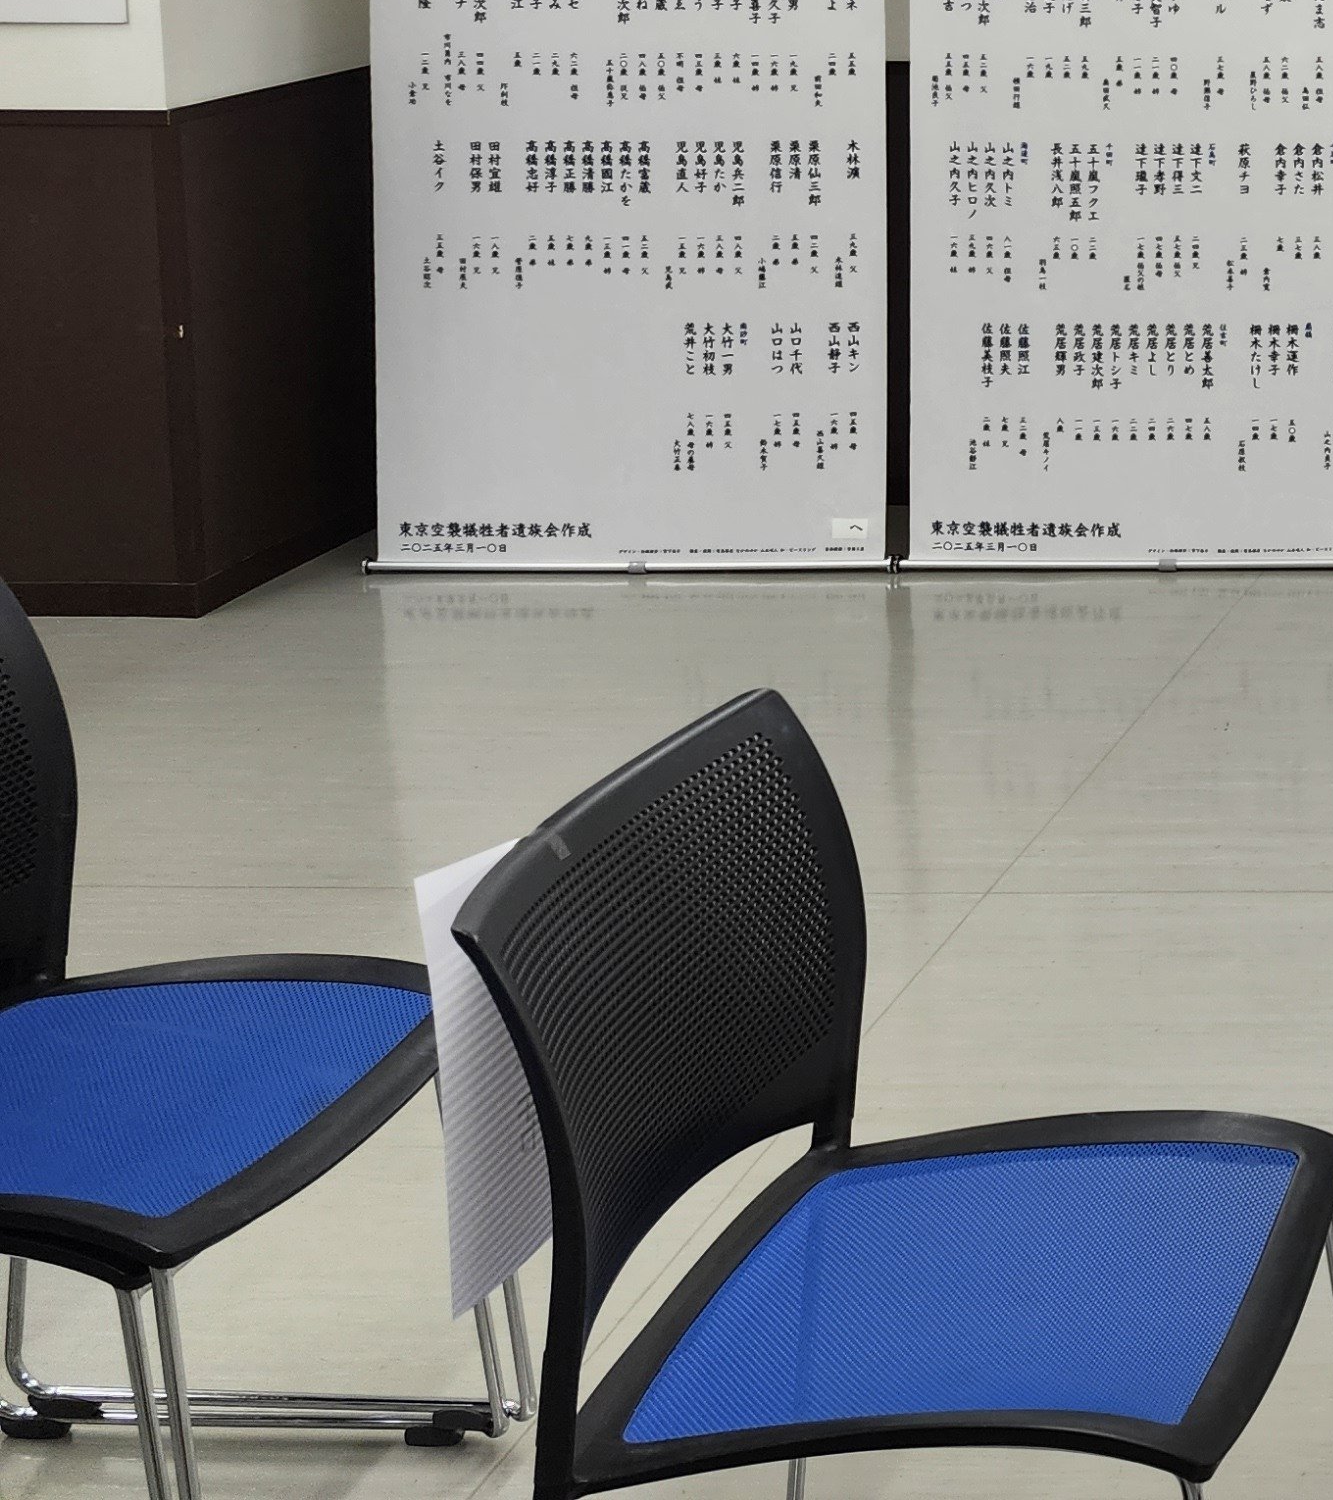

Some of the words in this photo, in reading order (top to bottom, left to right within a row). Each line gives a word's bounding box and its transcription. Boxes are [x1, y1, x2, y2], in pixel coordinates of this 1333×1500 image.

[432, 139, 448, 193] 土谷イク
[983, 141, 998, 208] 山之内久次
[1292, 142, 1307, 195] 倉内さた
[720, 321, 735, 377] 大竹一男
[788, 322, 803, 375] 山口千代
[846, 321, 861, 373] 西山キン
[1072, 322, 1087, 377] 荒居政子
[1145, 322, 1160, 377] 荒居よし
[398, 521, 592, 539] 東京空襲犠牲者遺族会作成
[930, 519, 1122, 539] 東京空襲犠牲者遺族会作成
